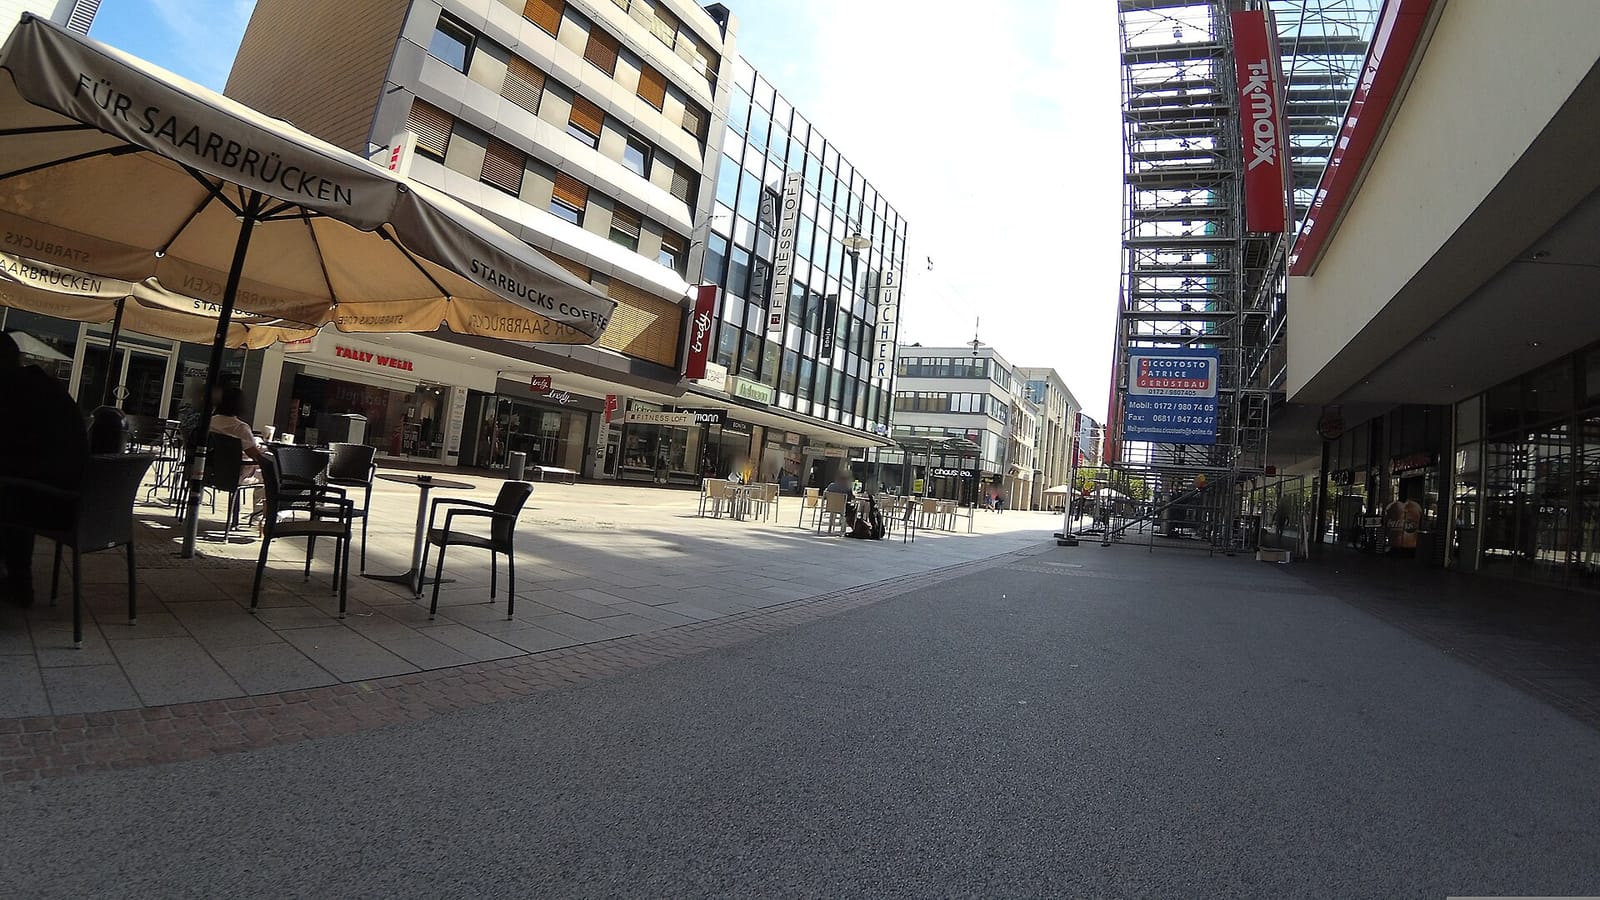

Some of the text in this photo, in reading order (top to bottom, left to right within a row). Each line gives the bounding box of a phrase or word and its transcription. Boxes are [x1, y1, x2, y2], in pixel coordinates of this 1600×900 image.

[74, 72, 353, 206] FÜR SAARBRÜCKEN
[773, 228, 792, 308] FITNESS
[784, 177, 798, 220] LOFT
[470, 259, 608, 331] STARBUCKS COFFEE
[692, 310, 711, 353] tredy
[878, 272, 893, 377] BÜCHER
[335, 346, 374, 363] TALLY
[544, 389, 574, 405] tredy
[1141, 379, 1205, 388] GERÜSTBAU
[636, 414, 669, 422] FITNESS
[1129, 401, 1152, 409] Mobil:
[1154, 402, 1172, 410] 0172
